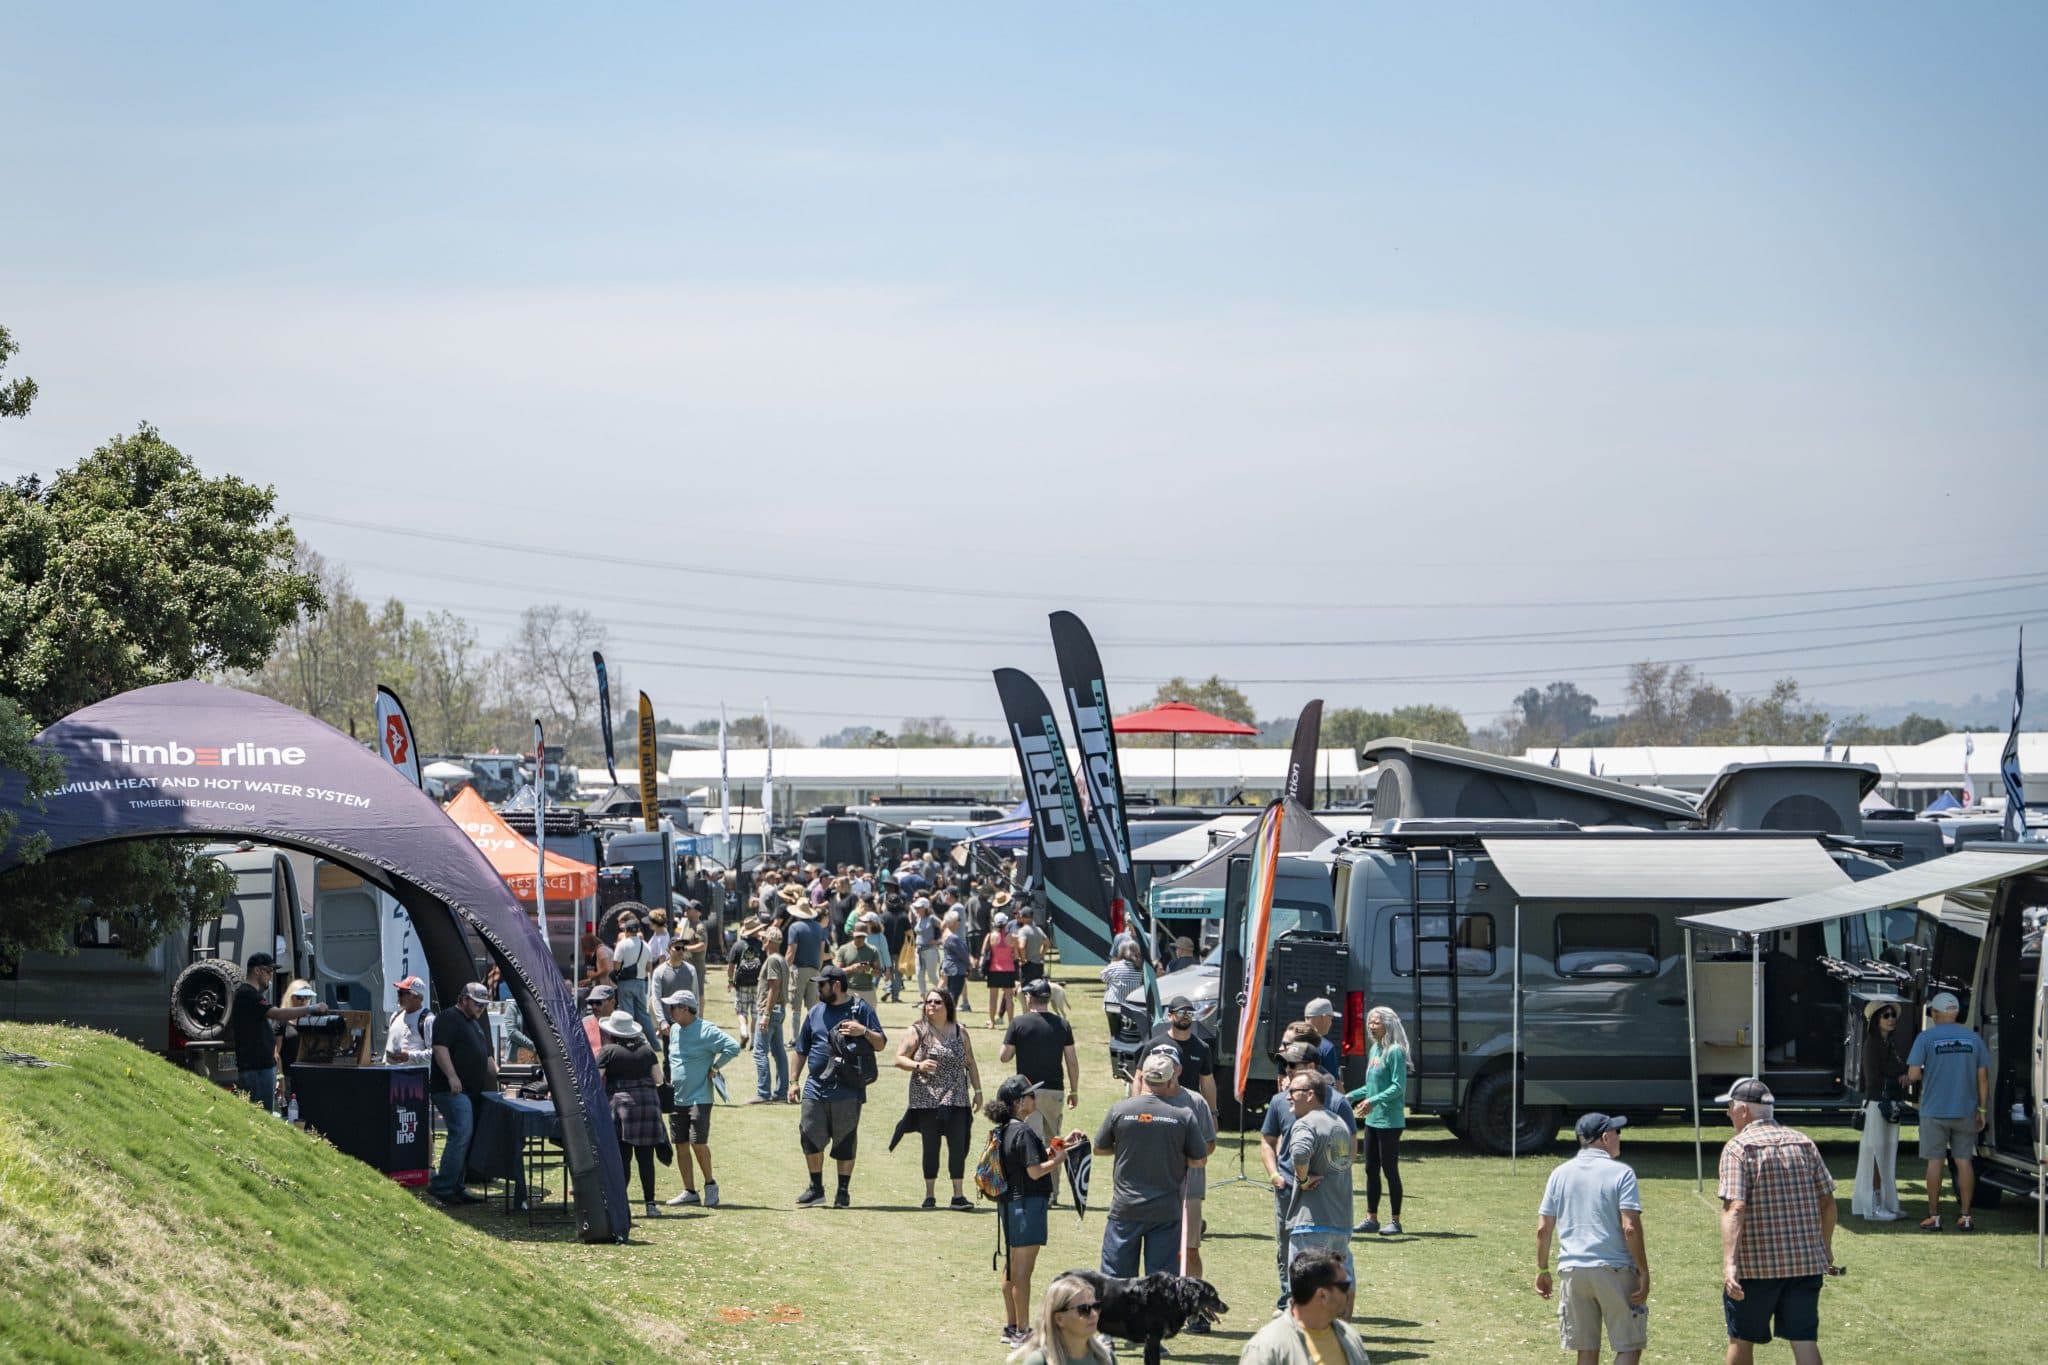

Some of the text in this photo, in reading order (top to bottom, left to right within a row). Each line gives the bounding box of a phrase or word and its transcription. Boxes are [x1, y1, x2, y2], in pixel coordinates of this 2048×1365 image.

[30, 777, 371, 809] EMIUM HEAT AND HOT WATER SYSTEM
[1046, 724, 1082, 842] OVERLAND
[129, 799, 256, 812] TIMBERLINEHEAT.COM
[396, 1130, 415, 1144] line
